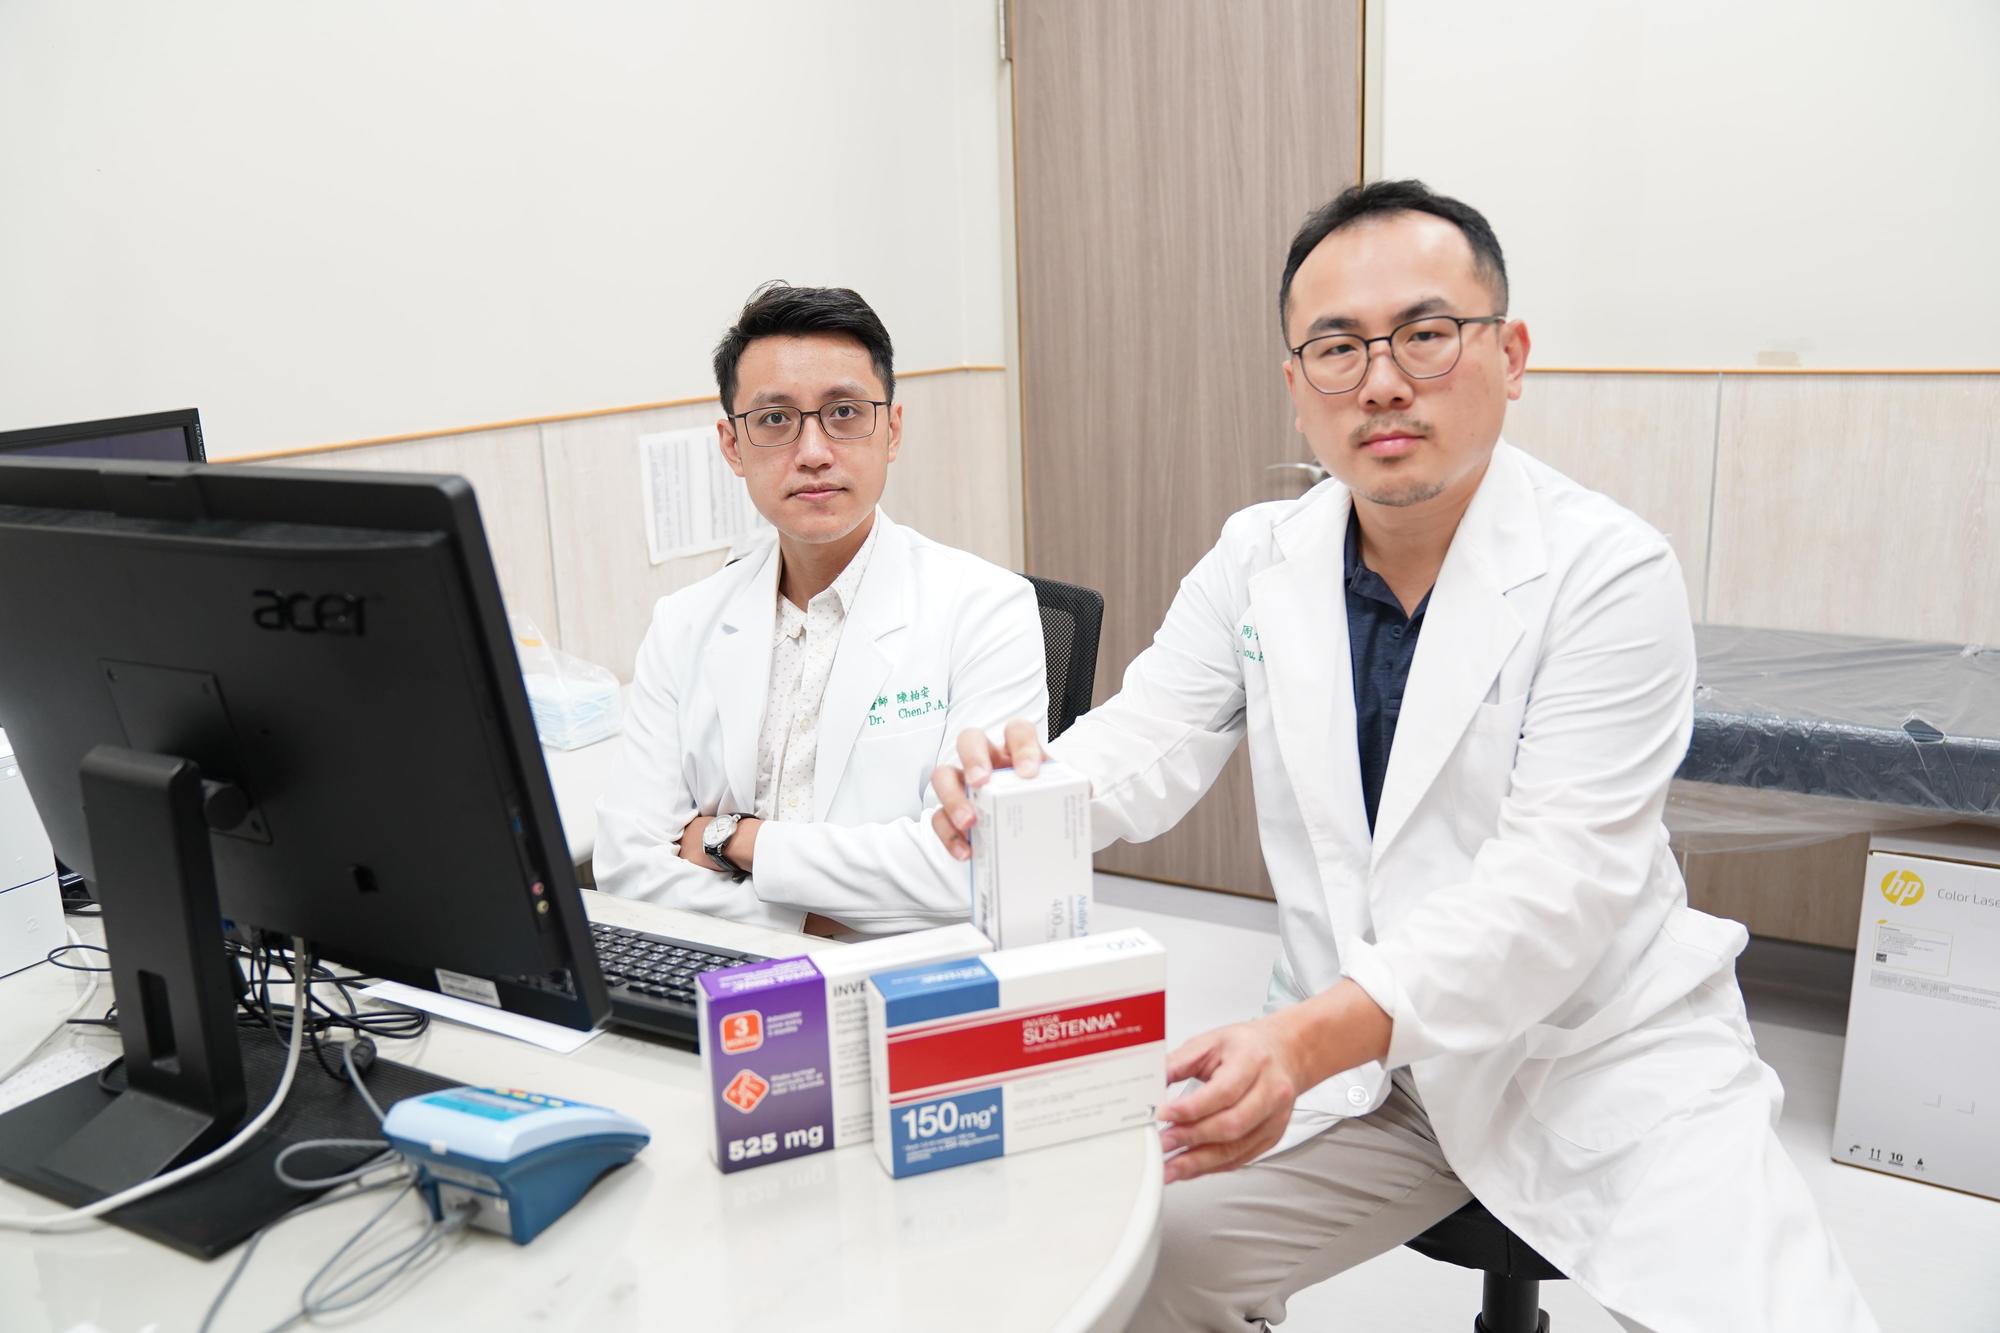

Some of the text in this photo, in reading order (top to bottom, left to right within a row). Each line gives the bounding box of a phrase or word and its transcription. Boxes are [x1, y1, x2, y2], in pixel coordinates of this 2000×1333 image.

[252, 588, 366, 637] acer
[868, 714, 886, 726] Dr.
[1884, 869, 1922, 906] hp
[1937, 887, 1969, 904] Color
[733, 1016, 750, 1039] 3
[728, 1132, 779, 1162] 525
[783, 1124, 825, 1149] mg
